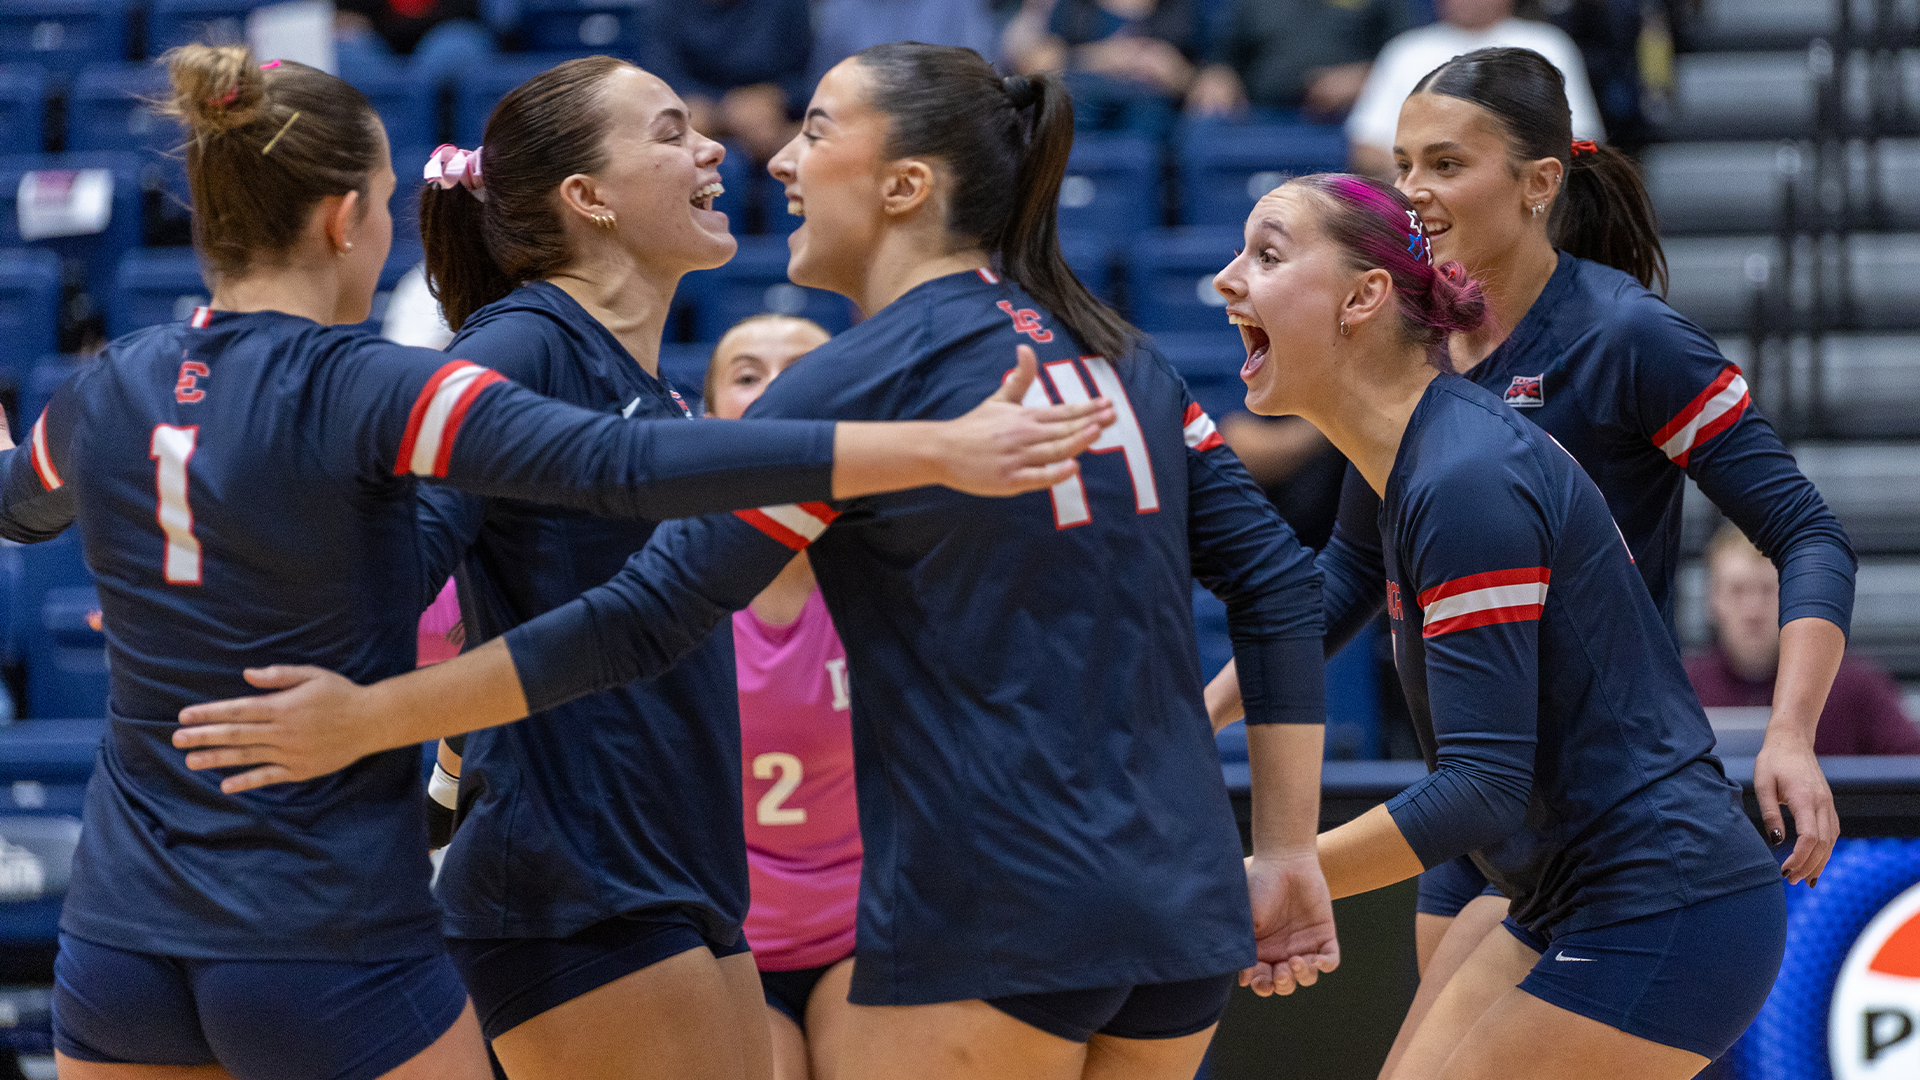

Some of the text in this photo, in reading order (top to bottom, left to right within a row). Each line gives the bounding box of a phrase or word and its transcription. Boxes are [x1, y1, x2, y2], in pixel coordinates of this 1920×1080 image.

[997, 300, 1053, 342] LC
[149, 422, 202, 586] 1
[752, 751, 808, 827] 2
